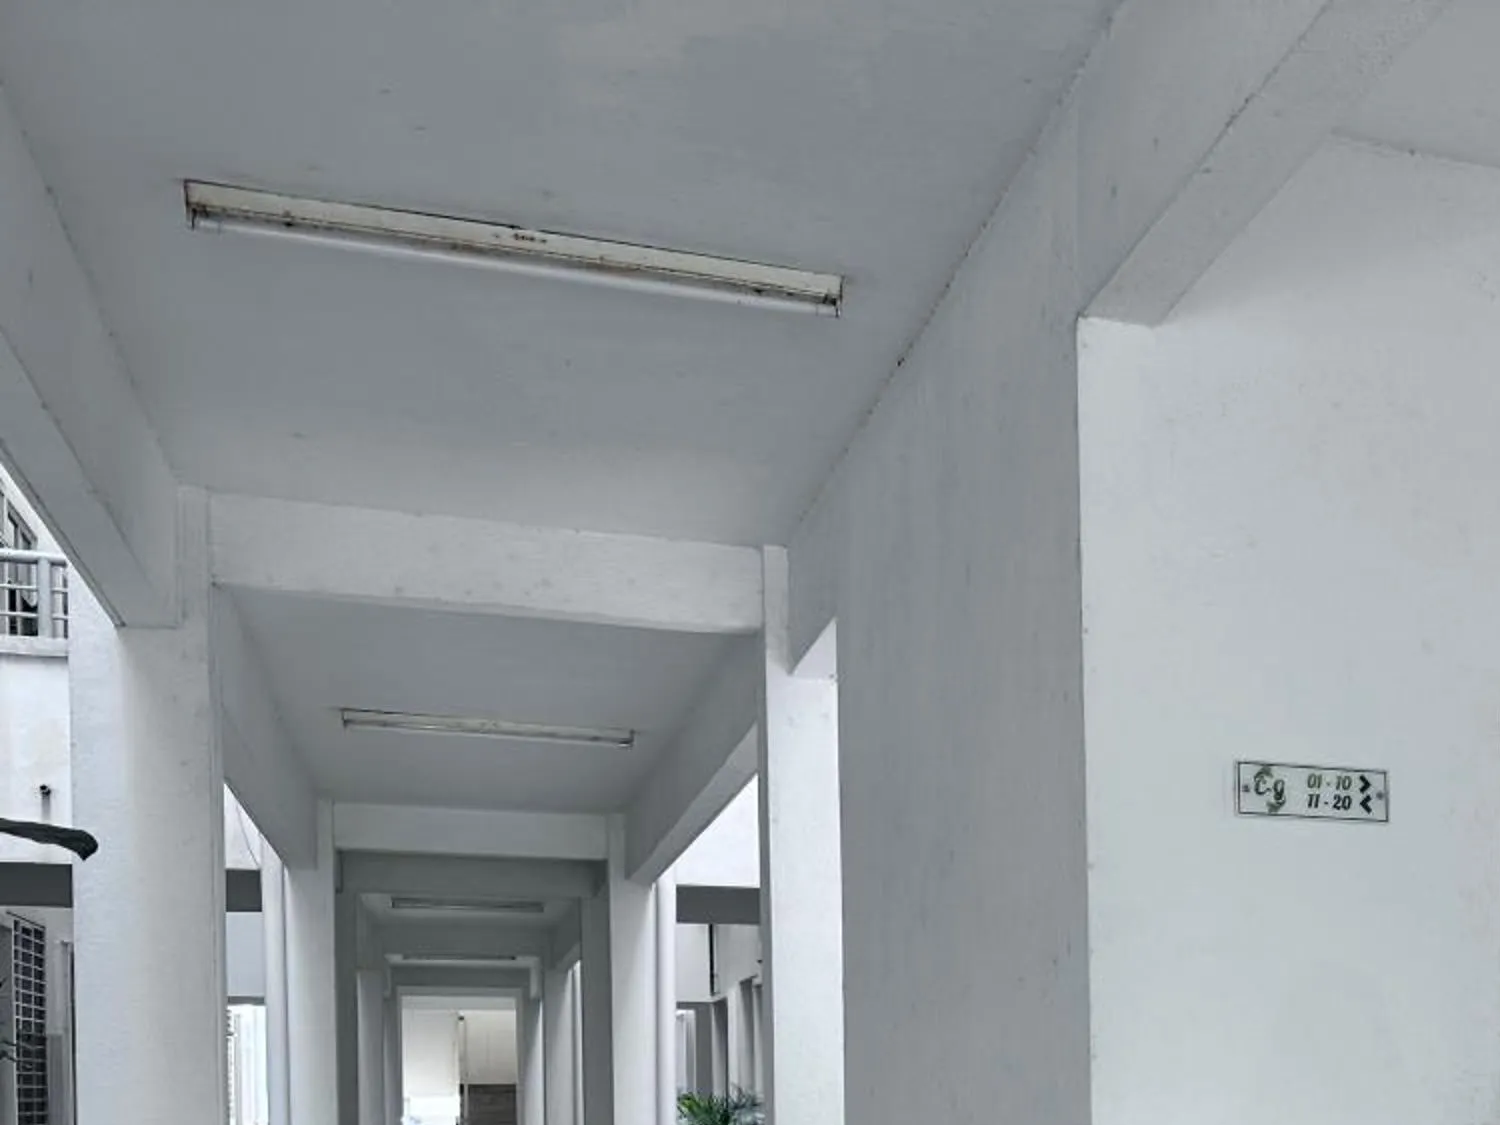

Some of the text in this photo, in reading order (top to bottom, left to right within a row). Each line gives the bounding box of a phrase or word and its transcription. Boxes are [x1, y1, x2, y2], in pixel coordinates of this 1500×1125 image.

[1307, 773, 1322, 789] 01
[1336, 775, 1352, 790] 10
[1308, 793, 1321, 808] 11
[1333, 794, 1352, 810] 20
